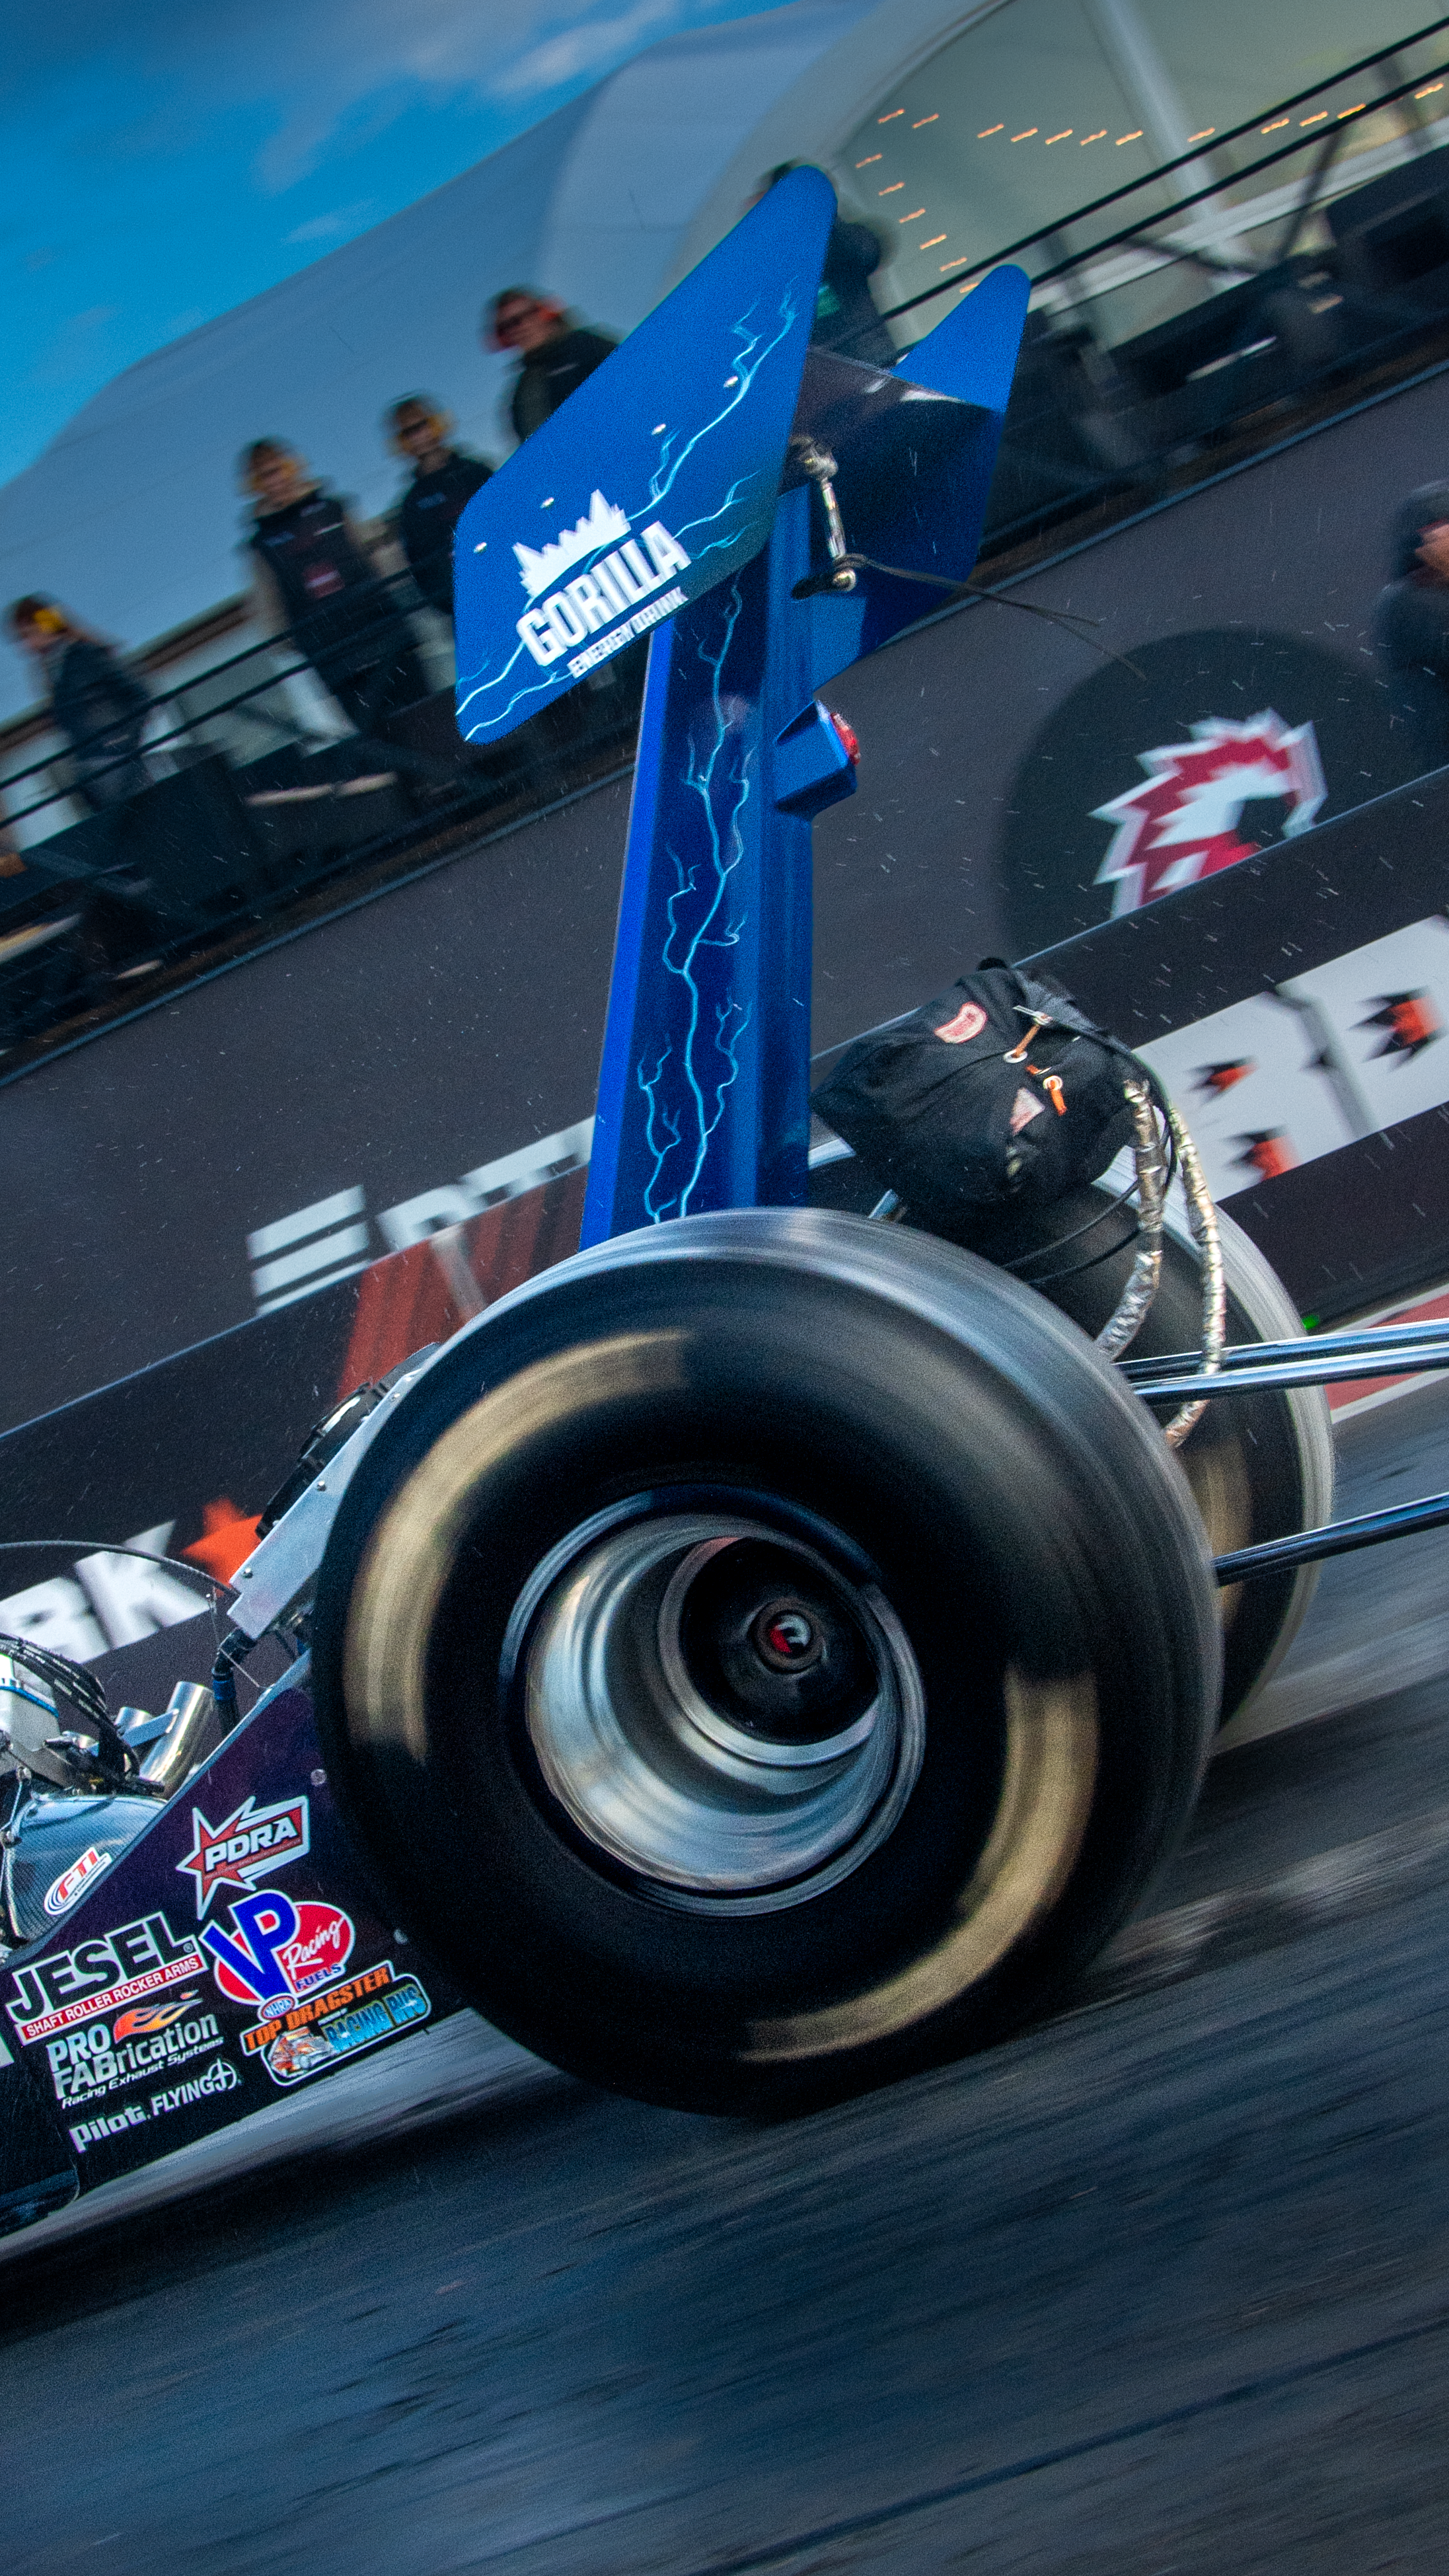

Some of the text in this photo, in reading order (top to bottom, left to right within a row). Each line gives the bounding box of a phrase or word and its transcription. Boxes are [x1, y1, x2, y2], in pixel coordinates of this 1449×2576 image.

[516, 520, 691, 666] GORILLA
[59, 1850, 98, 1900] FTI
[204, 1816, 298, 1872] PDRA
[9, 1914, 198, 2022] JESEL
[200, 1891, 299, 2001] VP
[282, 1915, 346, 1981] Racing
[295, 1963, 342, 1991] FUELS
[26, 1957, 199, 2037] SHAFT ROLLER ROCKER ARMS
[244, 2020, 282, 2051] TOP
[285, 1966, 392, 2031] DRAGSTER
[264, 1998, 293, 2018] NHRA
[46, 2023, 112, 2073] PRO
[52, 2013, 219, 2101] FABrication
[61, 2035, 225, 2109] Racing Exhaust Systems
